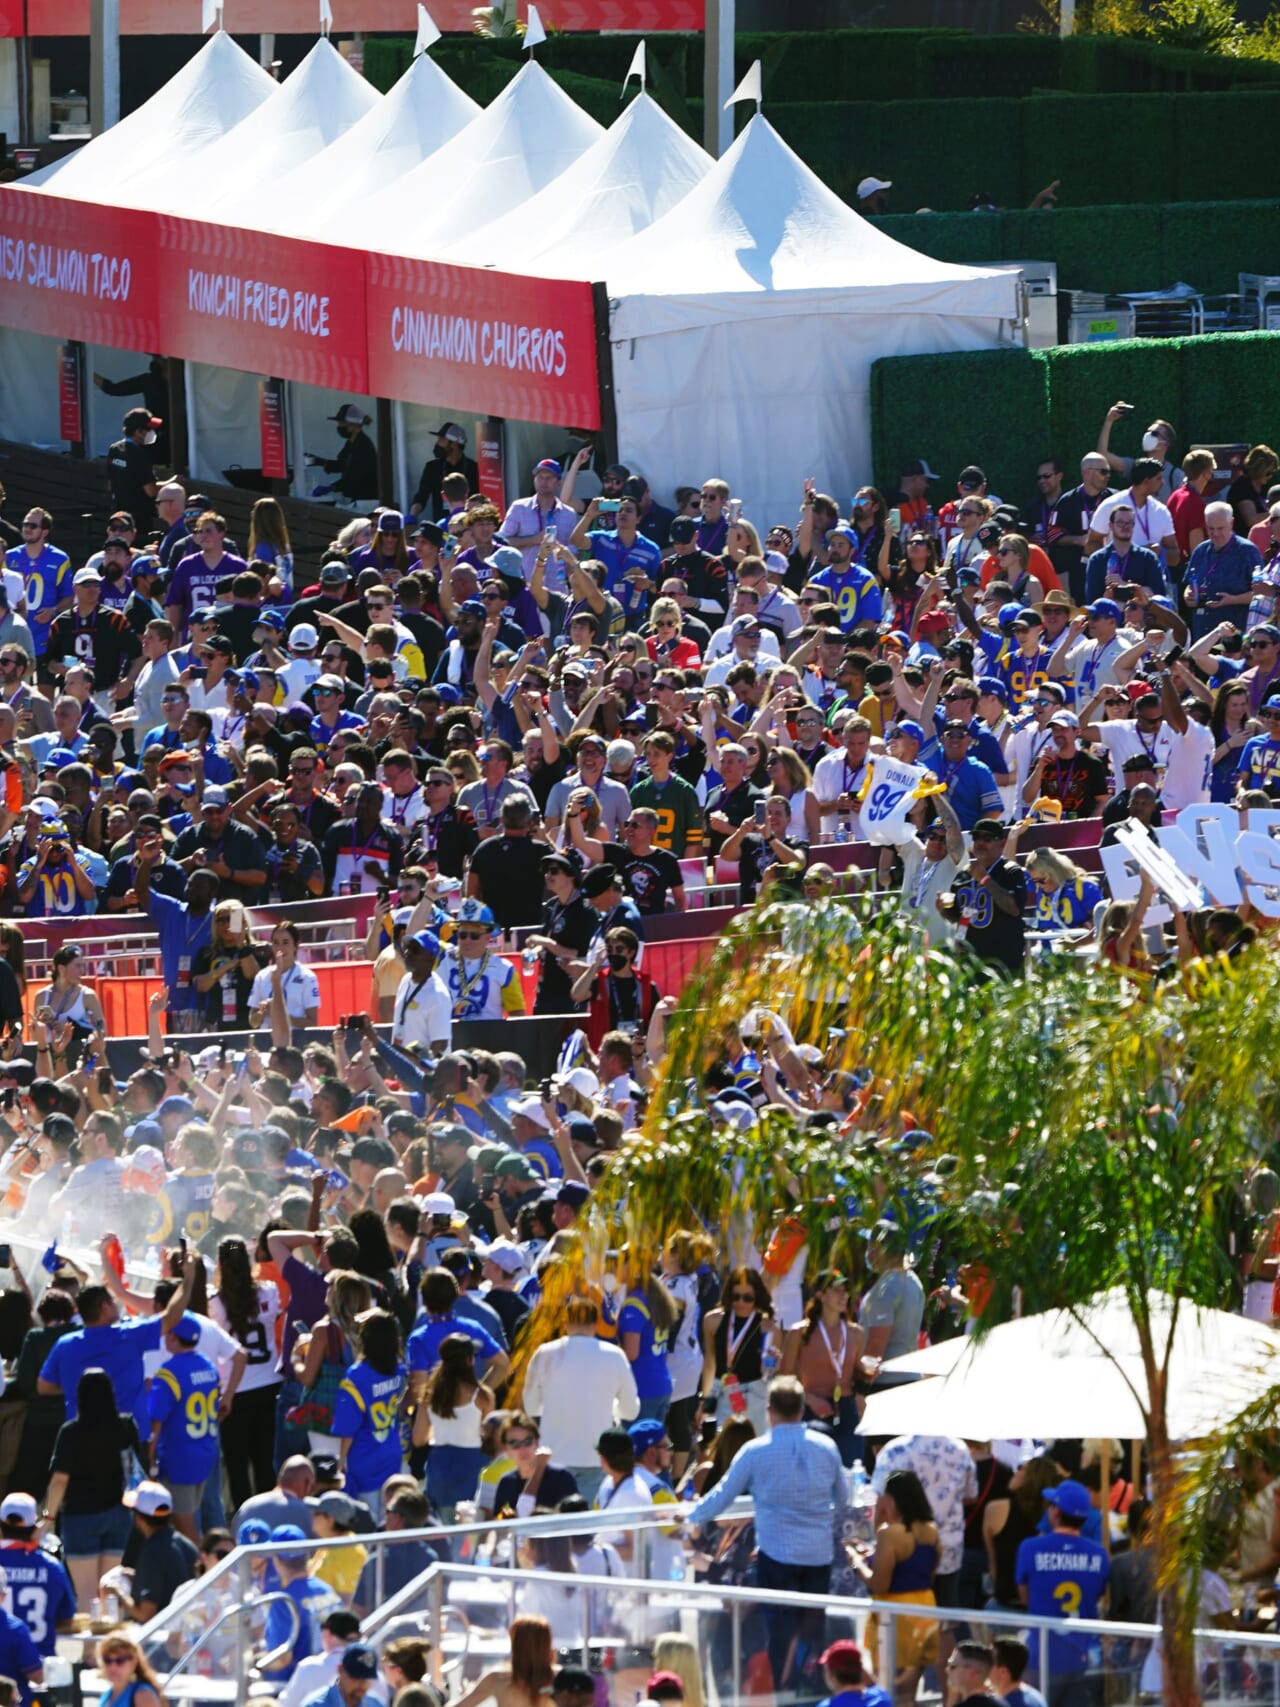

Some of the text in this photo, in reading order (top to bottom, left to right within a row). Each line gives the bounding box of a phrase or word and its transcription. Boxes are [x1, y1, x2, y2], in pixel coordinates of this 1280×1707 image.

[27, 242, 87, 297] SALMON
[90, 253, 131, 301] TACO
[188, 268, 331, 337] KIMCHI FRIED RICE
[391, 305, 568, 377] CINNAMON CHURROS
[886, 769, 916, 788] DONALD
[869, 783, 906, 823] 99
[42, 879, 77, 913] 10
[190, 1369, 218, 1385] DONALD
[1034, 1552, 1103, 1573] BECKHAM JR
[1, 1587, 48, 1643] 13
[1052, 1580, 1083, 1618] 3
